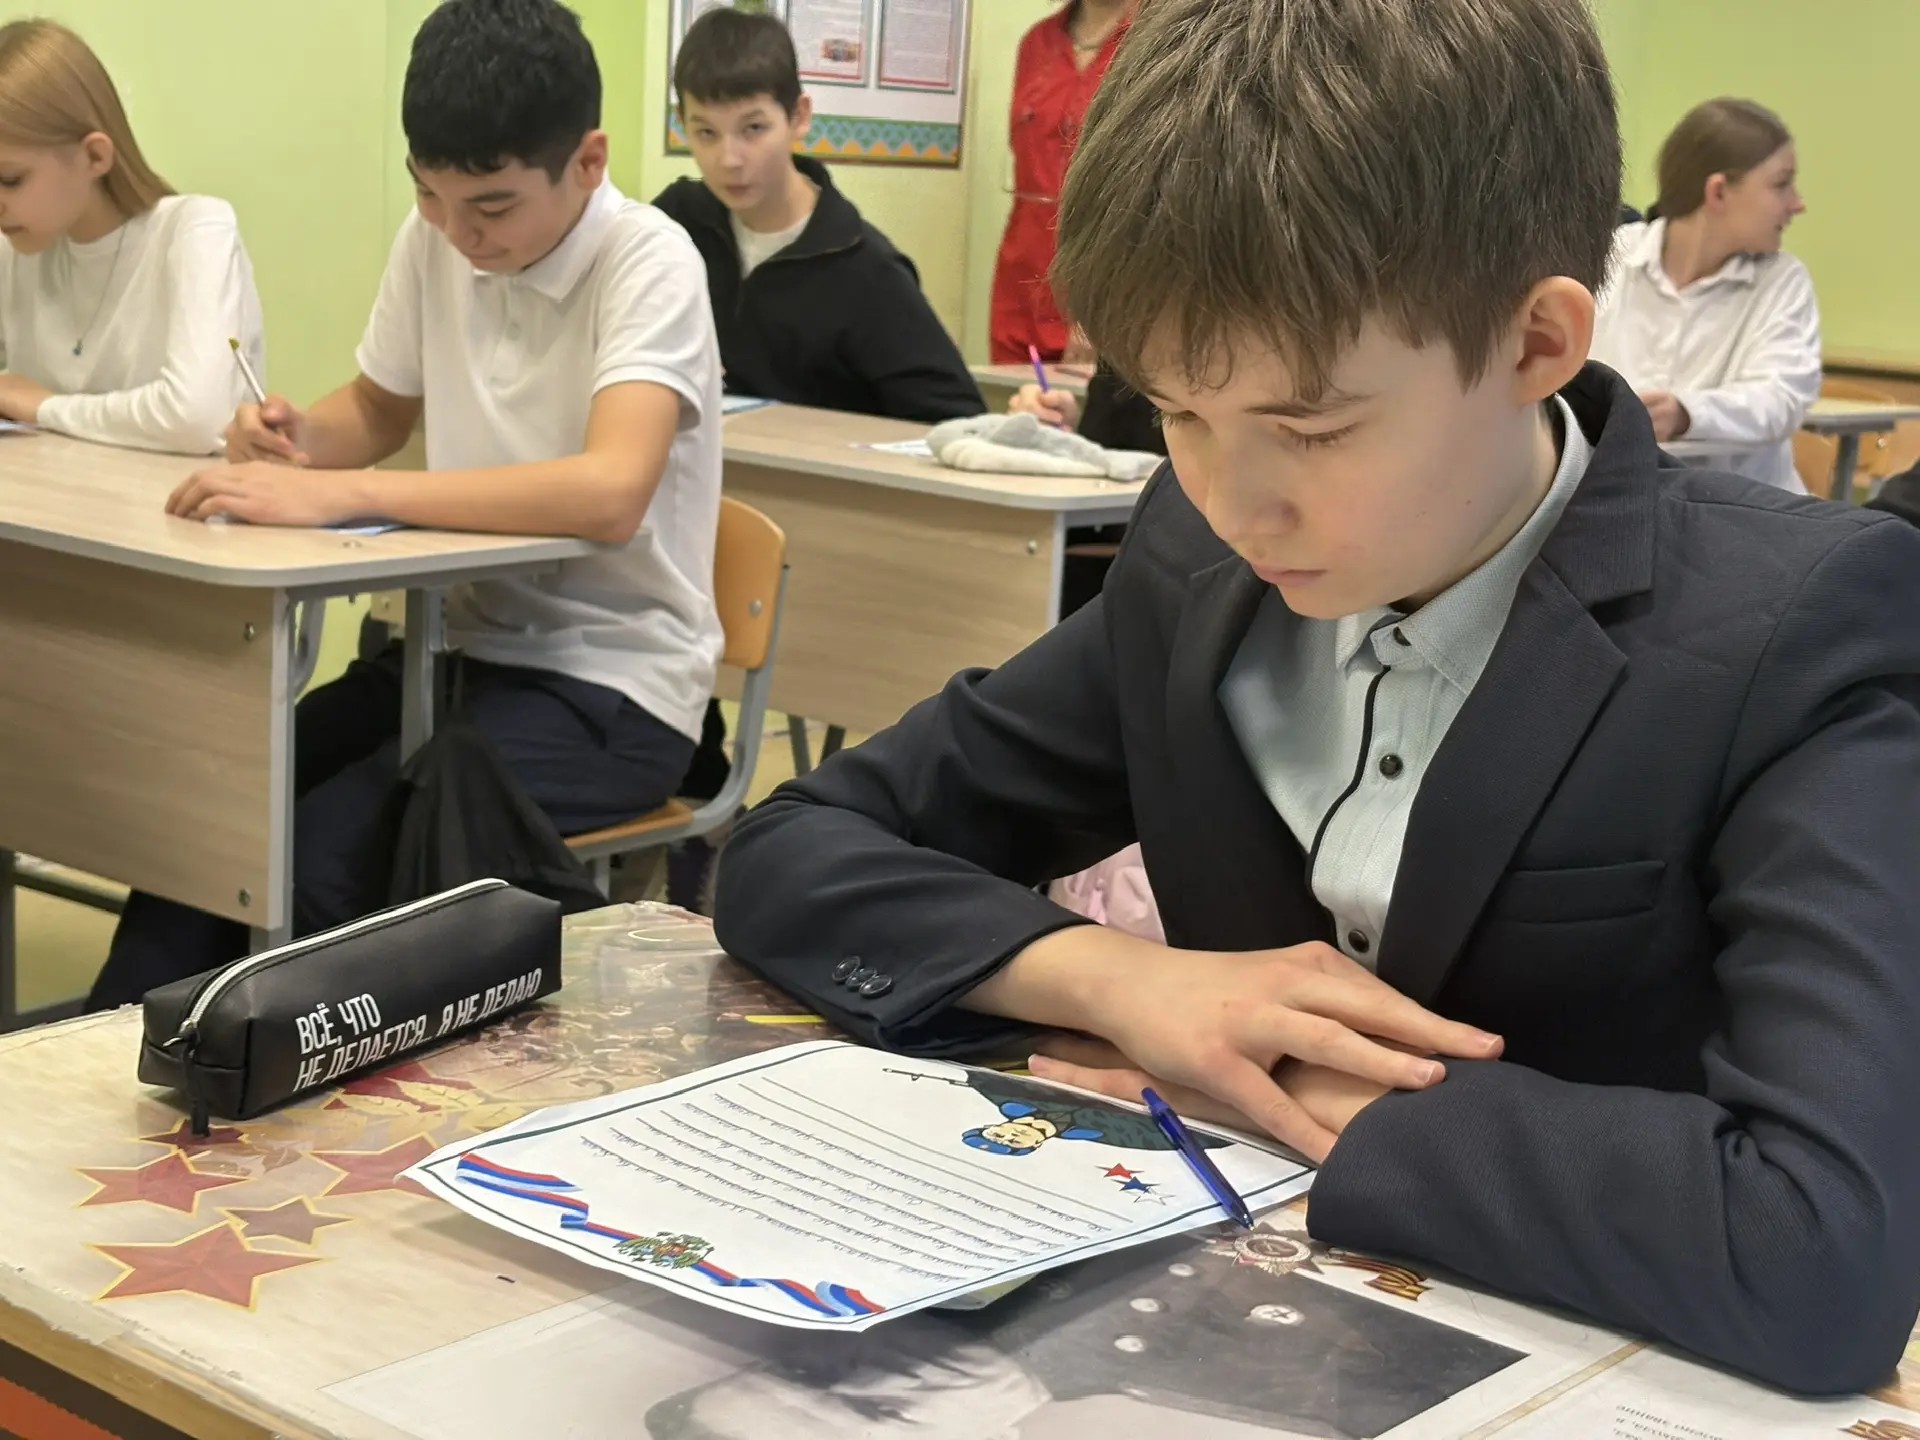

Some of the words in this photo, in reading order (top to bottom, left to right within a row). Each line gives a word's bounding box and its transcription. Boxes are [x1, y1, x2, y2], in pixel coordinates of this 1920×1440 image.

[292, 1053, 327, 1093] НЕ
[436, 1003, 454, 1038] Я
[452, 993, 480, 1030] НЕ
[475, 967, 543, 1022] ДЕЛАЮ
[295, 1002, 343, 1055] ВСЁ,
[337, 993, 382, 1036] ЧТО
